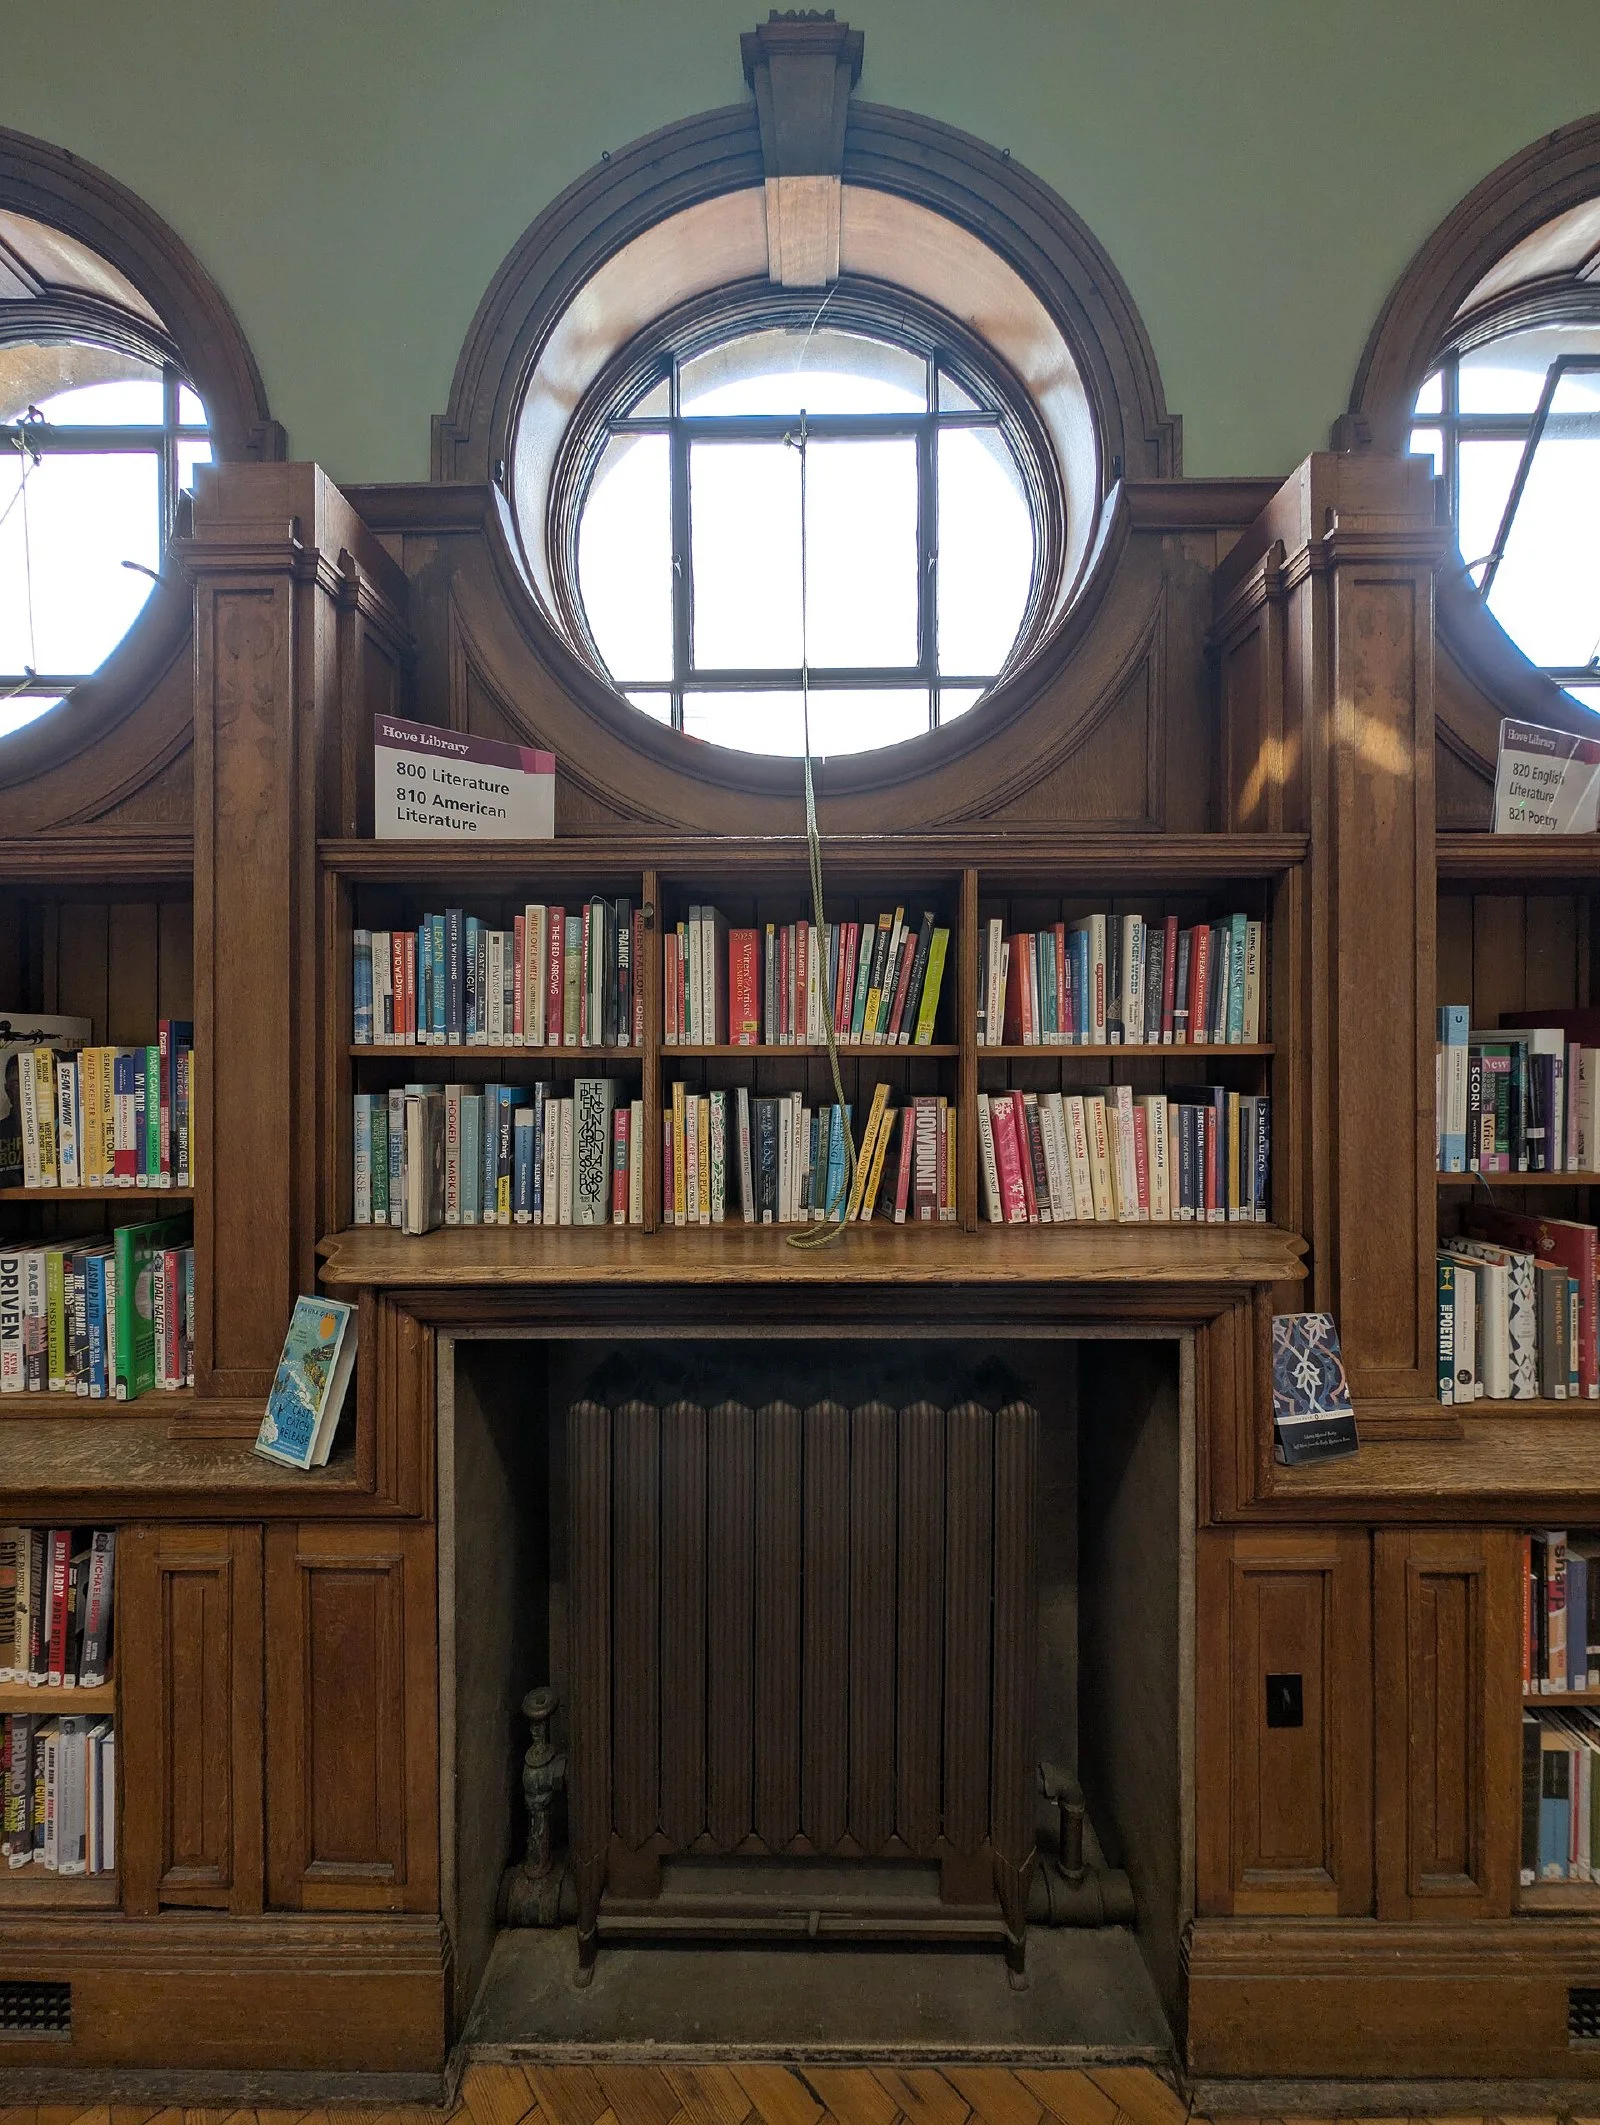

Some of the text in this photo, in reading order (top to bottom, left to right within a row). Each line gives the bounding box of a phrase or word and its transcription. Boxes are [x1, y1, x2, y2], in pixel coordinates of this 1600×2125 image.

[383, 725, 469, 754] Hove Library
[1508, 729, 1556, 750] Hove Library
[397, 762, 510, 795] 800 Literature
[1510, 782, 1554, 802] Literature
[1513, 763, 1565, 785] 820 English
[397, 788, 506, 818] 810 American
[397, 807, 477, 831] Literature
[1509, 808, 1557, 830] 821 Poetry
[619, 929, 629, 968] FRANKIE
[733, 932, 753, 940] 2025
[395, 956, 401, 965] TO
[1131, 964, 1139, 994] WORD
[1484, 1059, 1509, 1068] New
[61, 1068, 72, 1127] SEAN CONWAY
[135, 1073, 144, 1112] MY HOUR
[150, 1077, 158, 1125] CAVENDISH
[1471, 1066, 1480, 1111] SCORN
[106, 1116, 115, 1163] THE TOUR
[180, 1127, 188, 1149] HENRY
[357, 1111, 366, 1193] DREAM HORSE
[500, 1124, 508, 1159] Fly Fishing
[617, 1117, 626, 1165] WRITTEN
[762, 1131, 773, 1172] story
[916, 1106, 936, 1194] HOWDUNIT
[980, 1108, 999, 1194] STRESSED unstressed
[1046, 1130, 1054, 1149] LIKE
[1076, 1128, 1084, 1159] HUMAN
[1483, 1117, 1493, 1151] Africa
[448, 1100, 456, 1209] HOOKED MARK HIX
[1032, 1125, 1046, 1183] 100 POETS
[1048, 1151, 1056, 1176] LIONS
[29, 1265, 38, 1296] RACE
[88, 1262, 99, 1318] JASON PLATO
[0, 1259, 19, 1340] DRIVEN
[49, 1297, 57, 1333] JENSON
[74, 1275, 86, 1336] THE MECHANIC
[154, 1276, 163, 1335] ROAD RACER
[1440, 1312, 1453, 1356] POETRY
[10, 1352, 18, 1375] KEVIN
[286, 1417, 310, 1432] CATCH
[54, 1542, 66, 1597] DAN HARDY
[93, 1555, 104, 1598] MICHAEL
[1550, 1545, 1566, 1611] sharp
[11, 1728, 27, 1795] BRUNO
